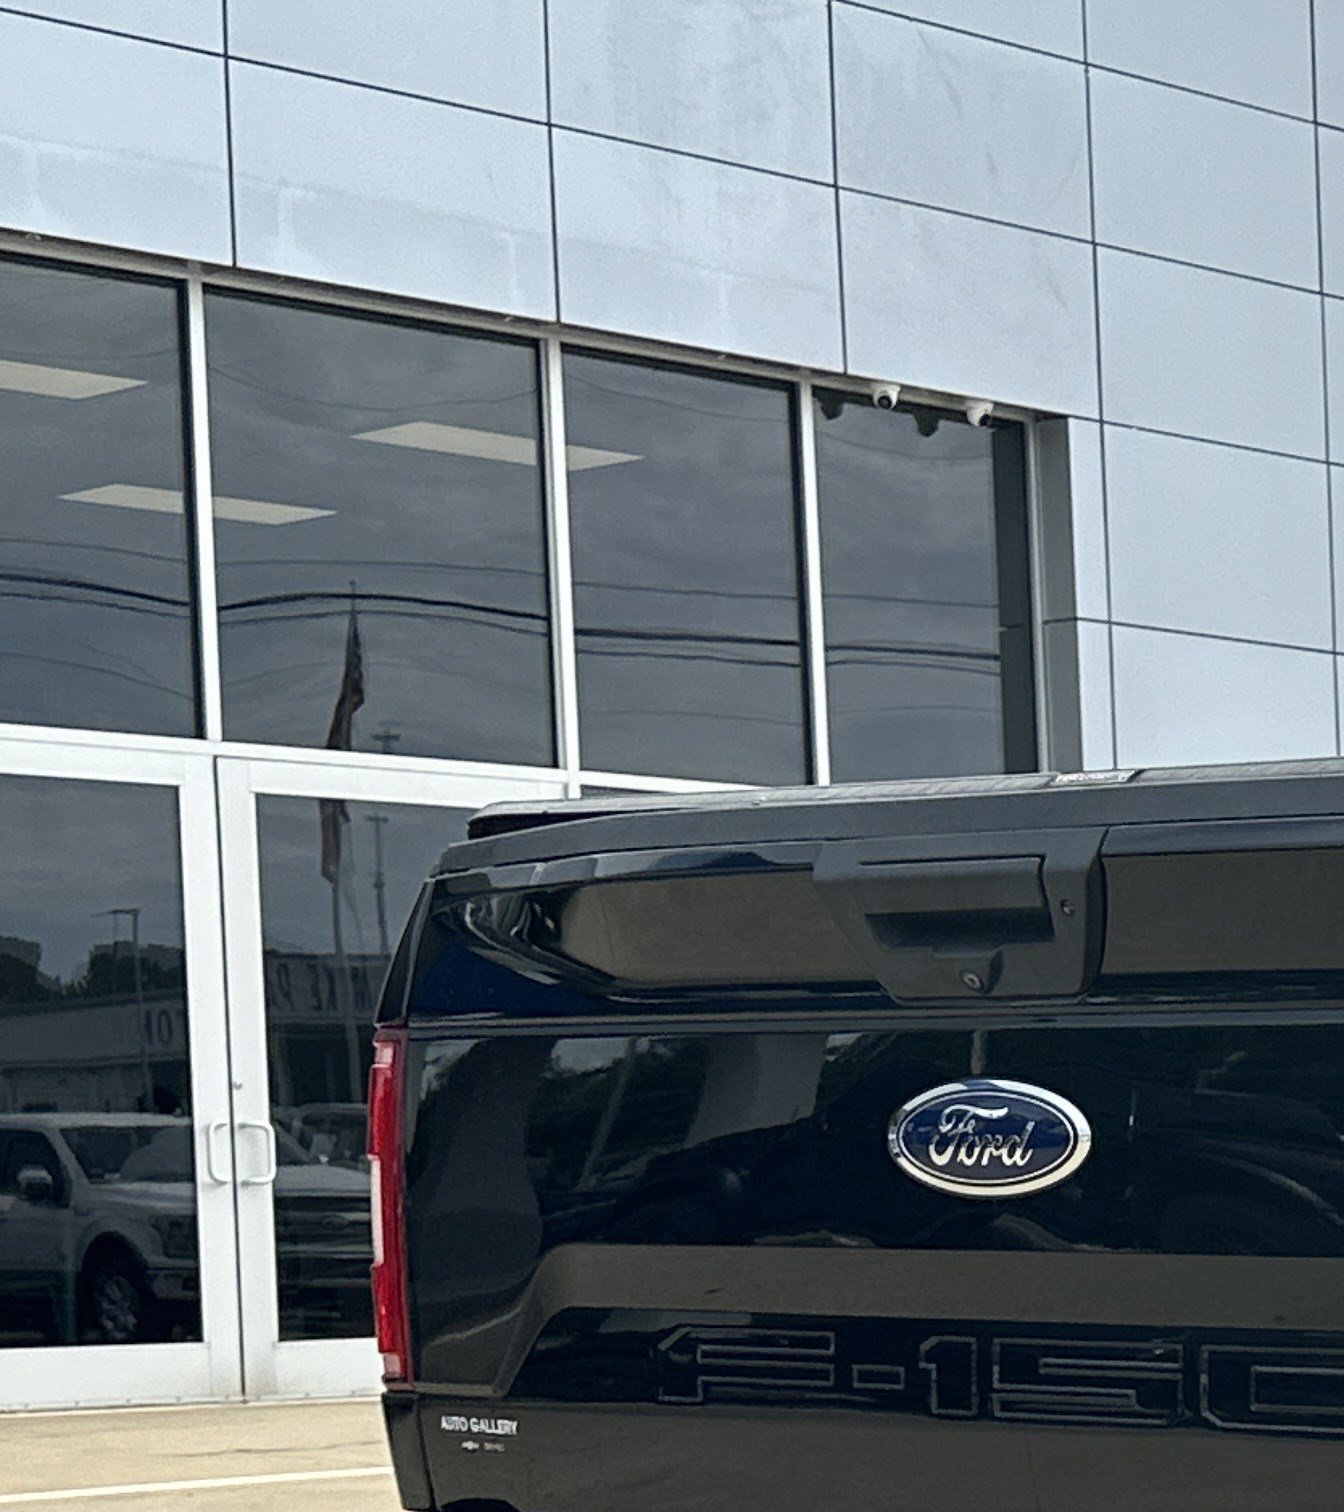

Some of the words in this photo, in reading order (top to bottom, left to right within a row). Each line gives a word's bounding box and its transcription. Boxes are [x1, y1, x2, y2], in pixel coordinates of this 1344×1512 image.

[928, 1103, 1036, 1167] Ford
[441, 1415, 468, 1432] AUTO
[470, 1417, 518, 1435] GALLERY
